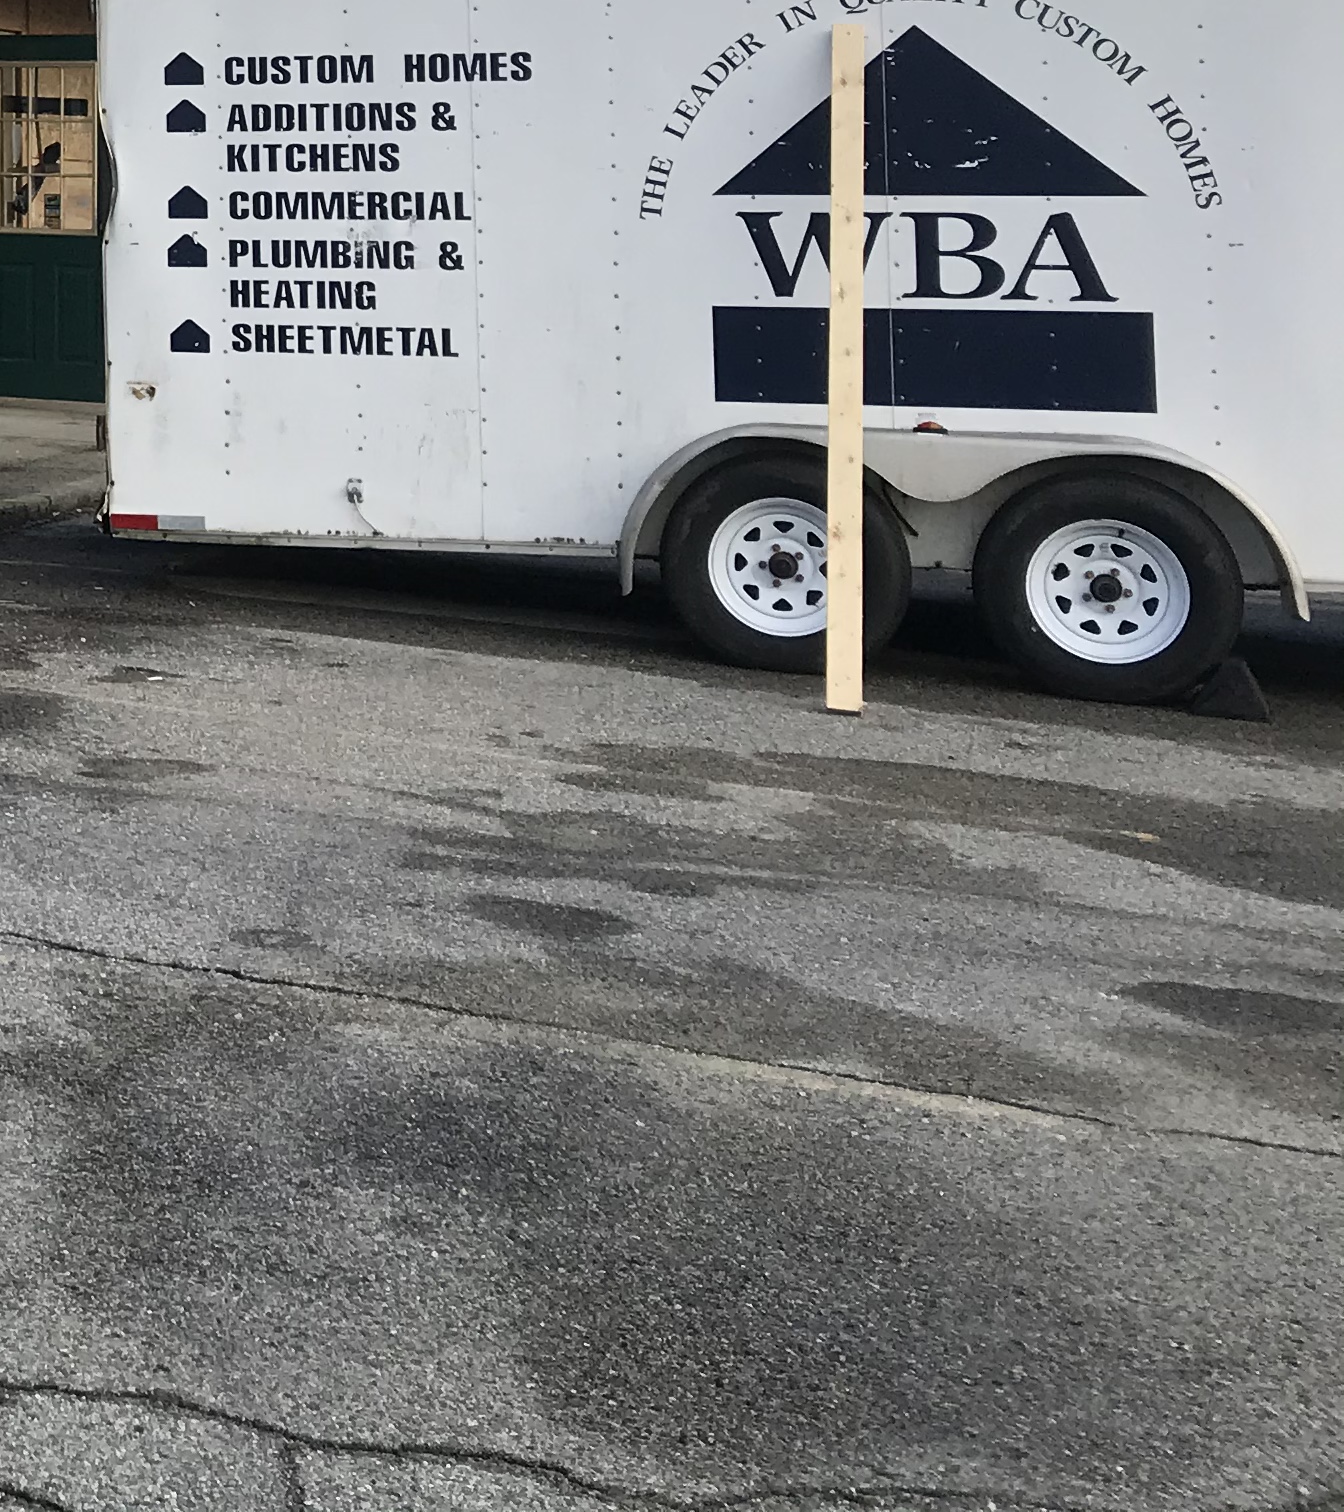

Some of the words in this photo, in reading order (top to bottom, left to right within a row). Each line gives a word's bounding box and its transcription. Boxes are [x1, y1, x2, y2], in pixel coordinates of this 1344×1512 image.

[224, 55, 374, 86] CUSTOM
[403, 52, 532, 83] HOMES
[226, 102, 417, 132] ADDITIONS
[431, 101, 458, 132] &
[639, 155, 674, 220] THE
[663, 32, 766, 141] LEADER
[775, 0, 817, 33] IN
[1147, 93, 1223, 210] HOMES
[226, 143, 400, 173] KITCHENS
[229, 191, 472, 221] COMMERCIAL
[228, 239, 415, 270] PLUMBING
[438, 240, 465, 271] &
[735, 211, 1120, 303] WBA
[229, 279, 377, 311] HEATING
[231, 323, 459, 358] SHEETMETAL
